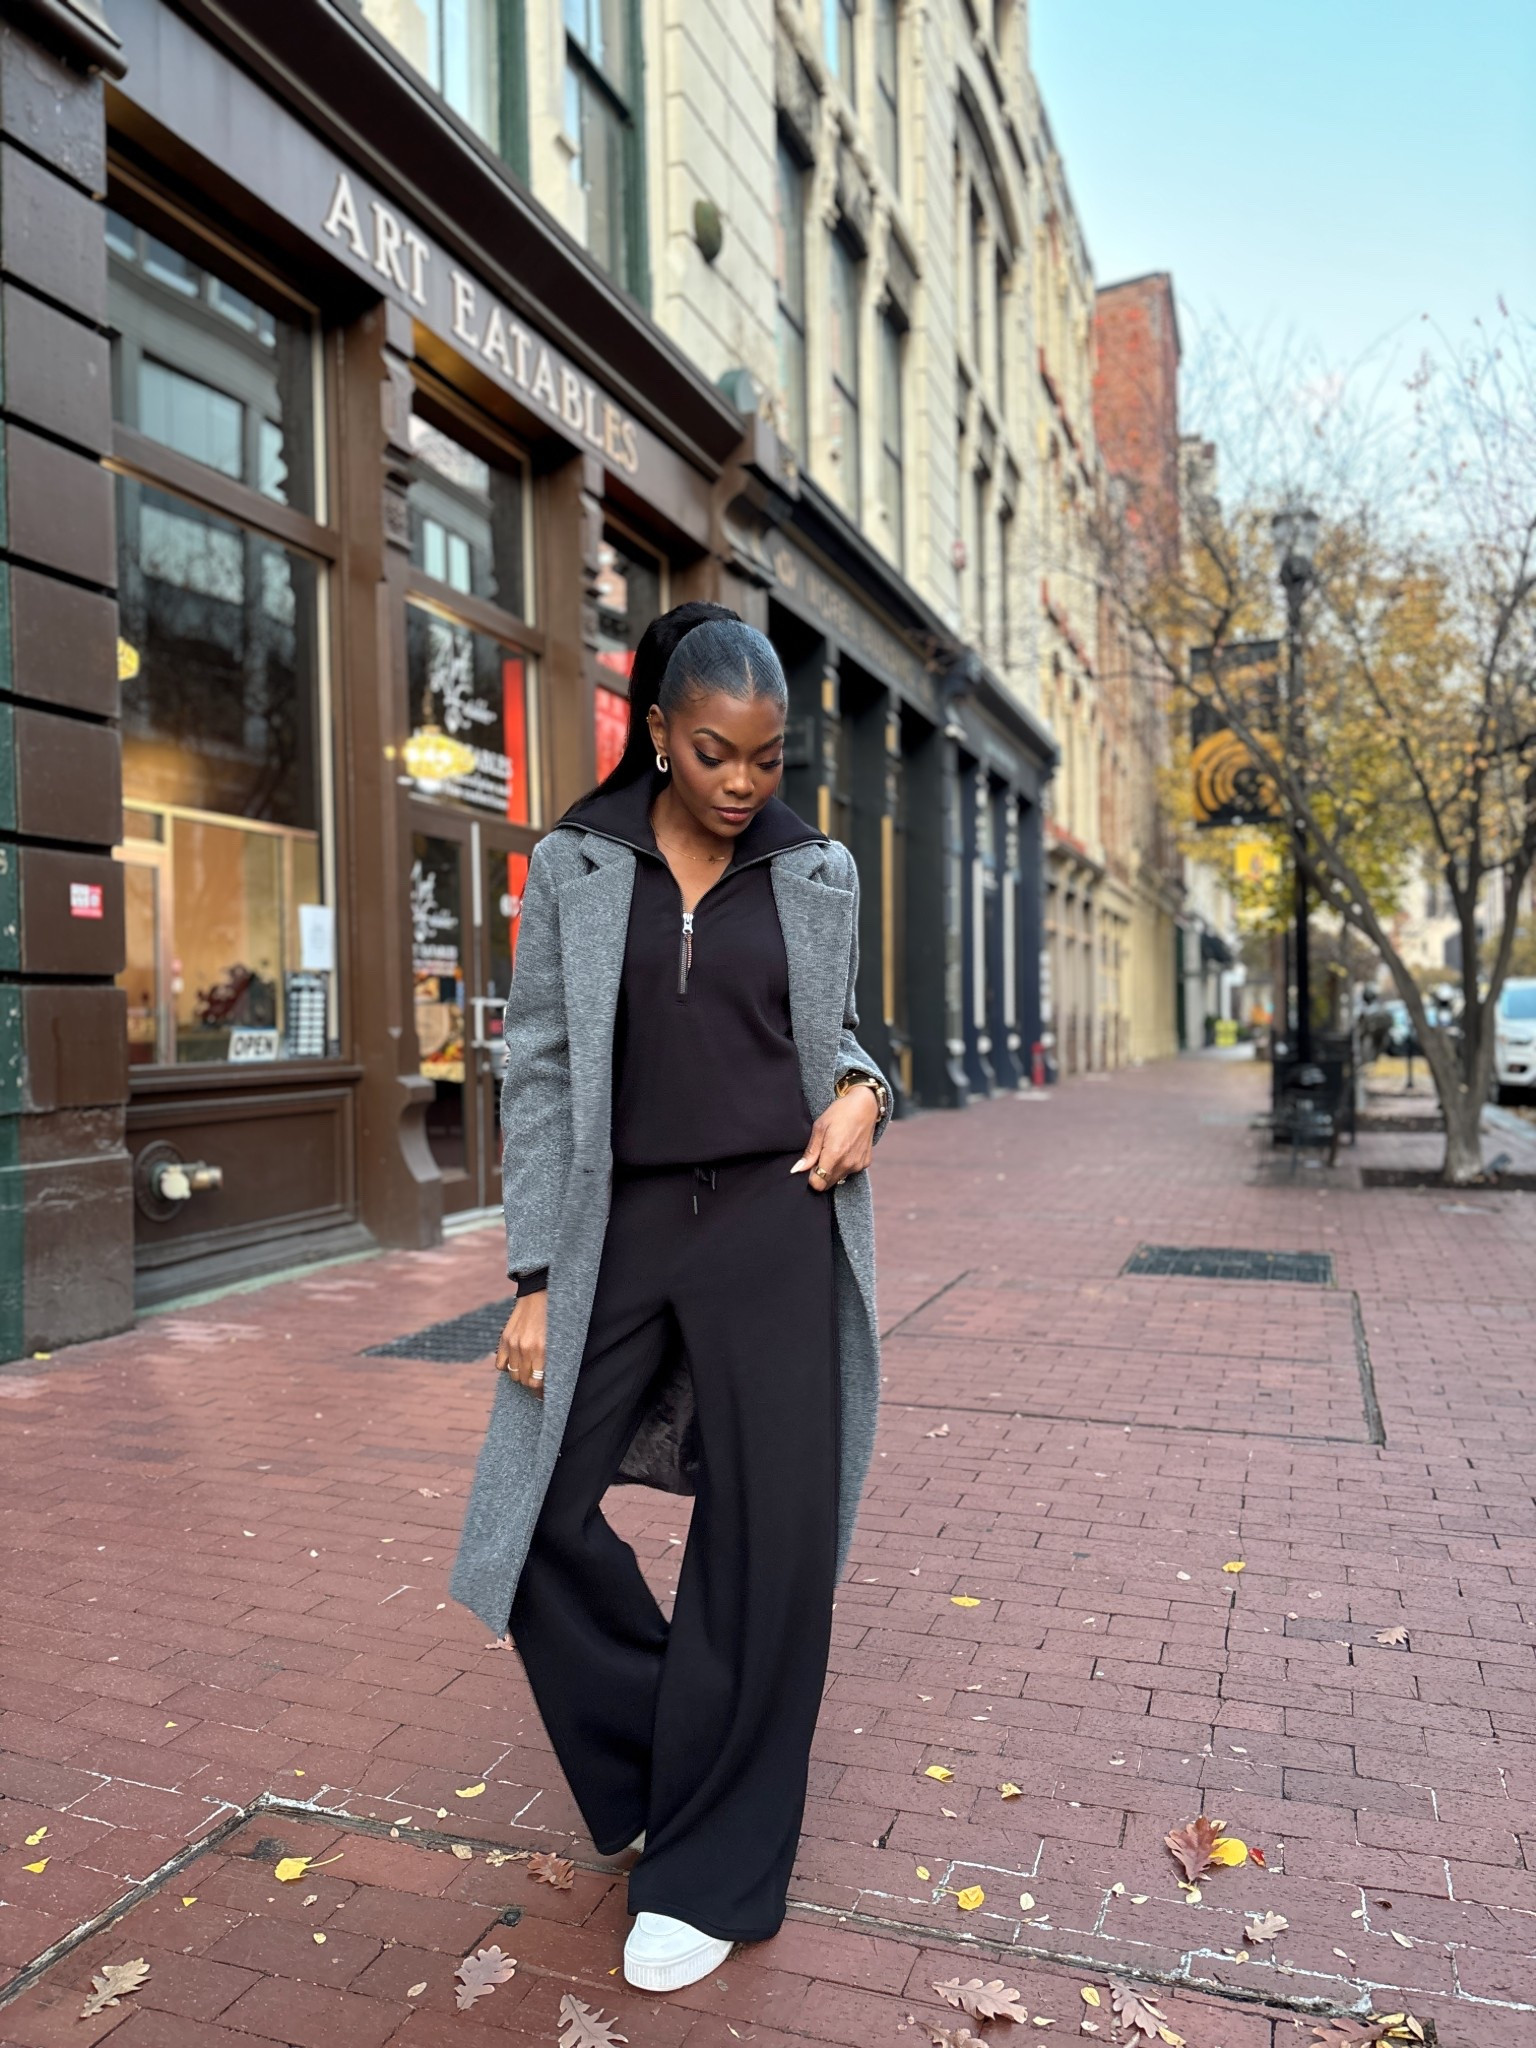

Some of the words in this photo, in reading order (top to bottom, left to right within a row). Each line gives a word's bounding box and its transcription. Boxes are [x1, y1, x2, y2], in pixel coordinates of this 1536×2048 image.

[323, 173, 431, 307] ART
[450, 269, 640, 474] EATABLES
[233, 1035, 274, 1057] OPEN
